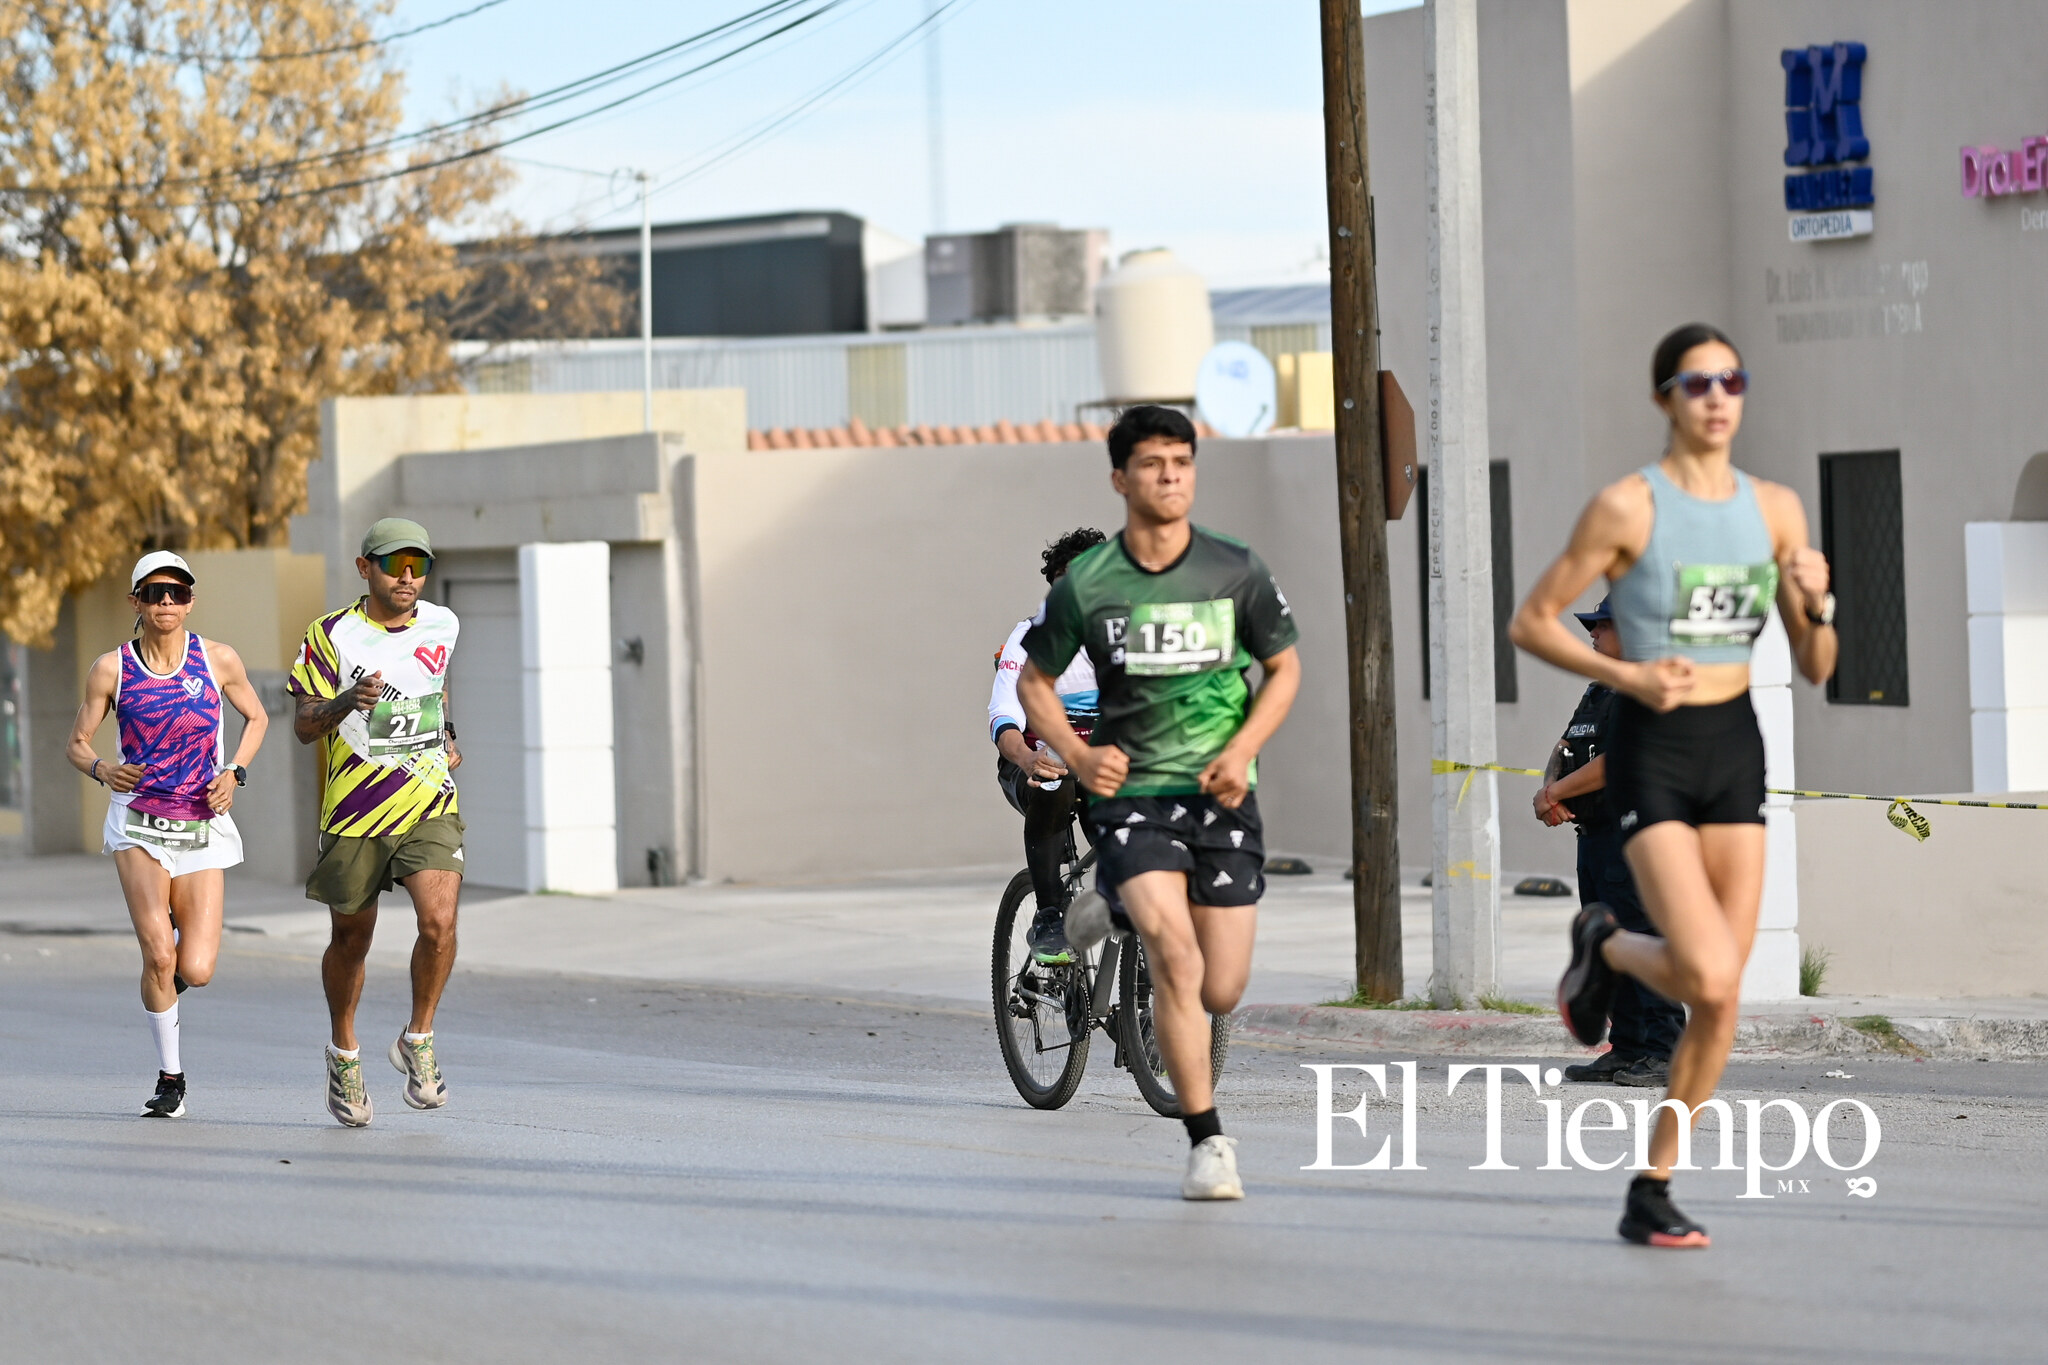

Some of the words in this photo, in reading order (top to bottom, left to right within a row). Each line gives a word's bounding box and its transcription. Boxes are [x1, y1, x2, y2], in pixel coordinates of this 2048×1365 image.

[1961, 146, 2018, 199] Dra.
[1792, 213, 1853, 238] ORTOPEDIA
[1688, 583, 1760, 620] 557
[1139, 621, 1207, 653] 150
[389, 711, 423, 738] 27
